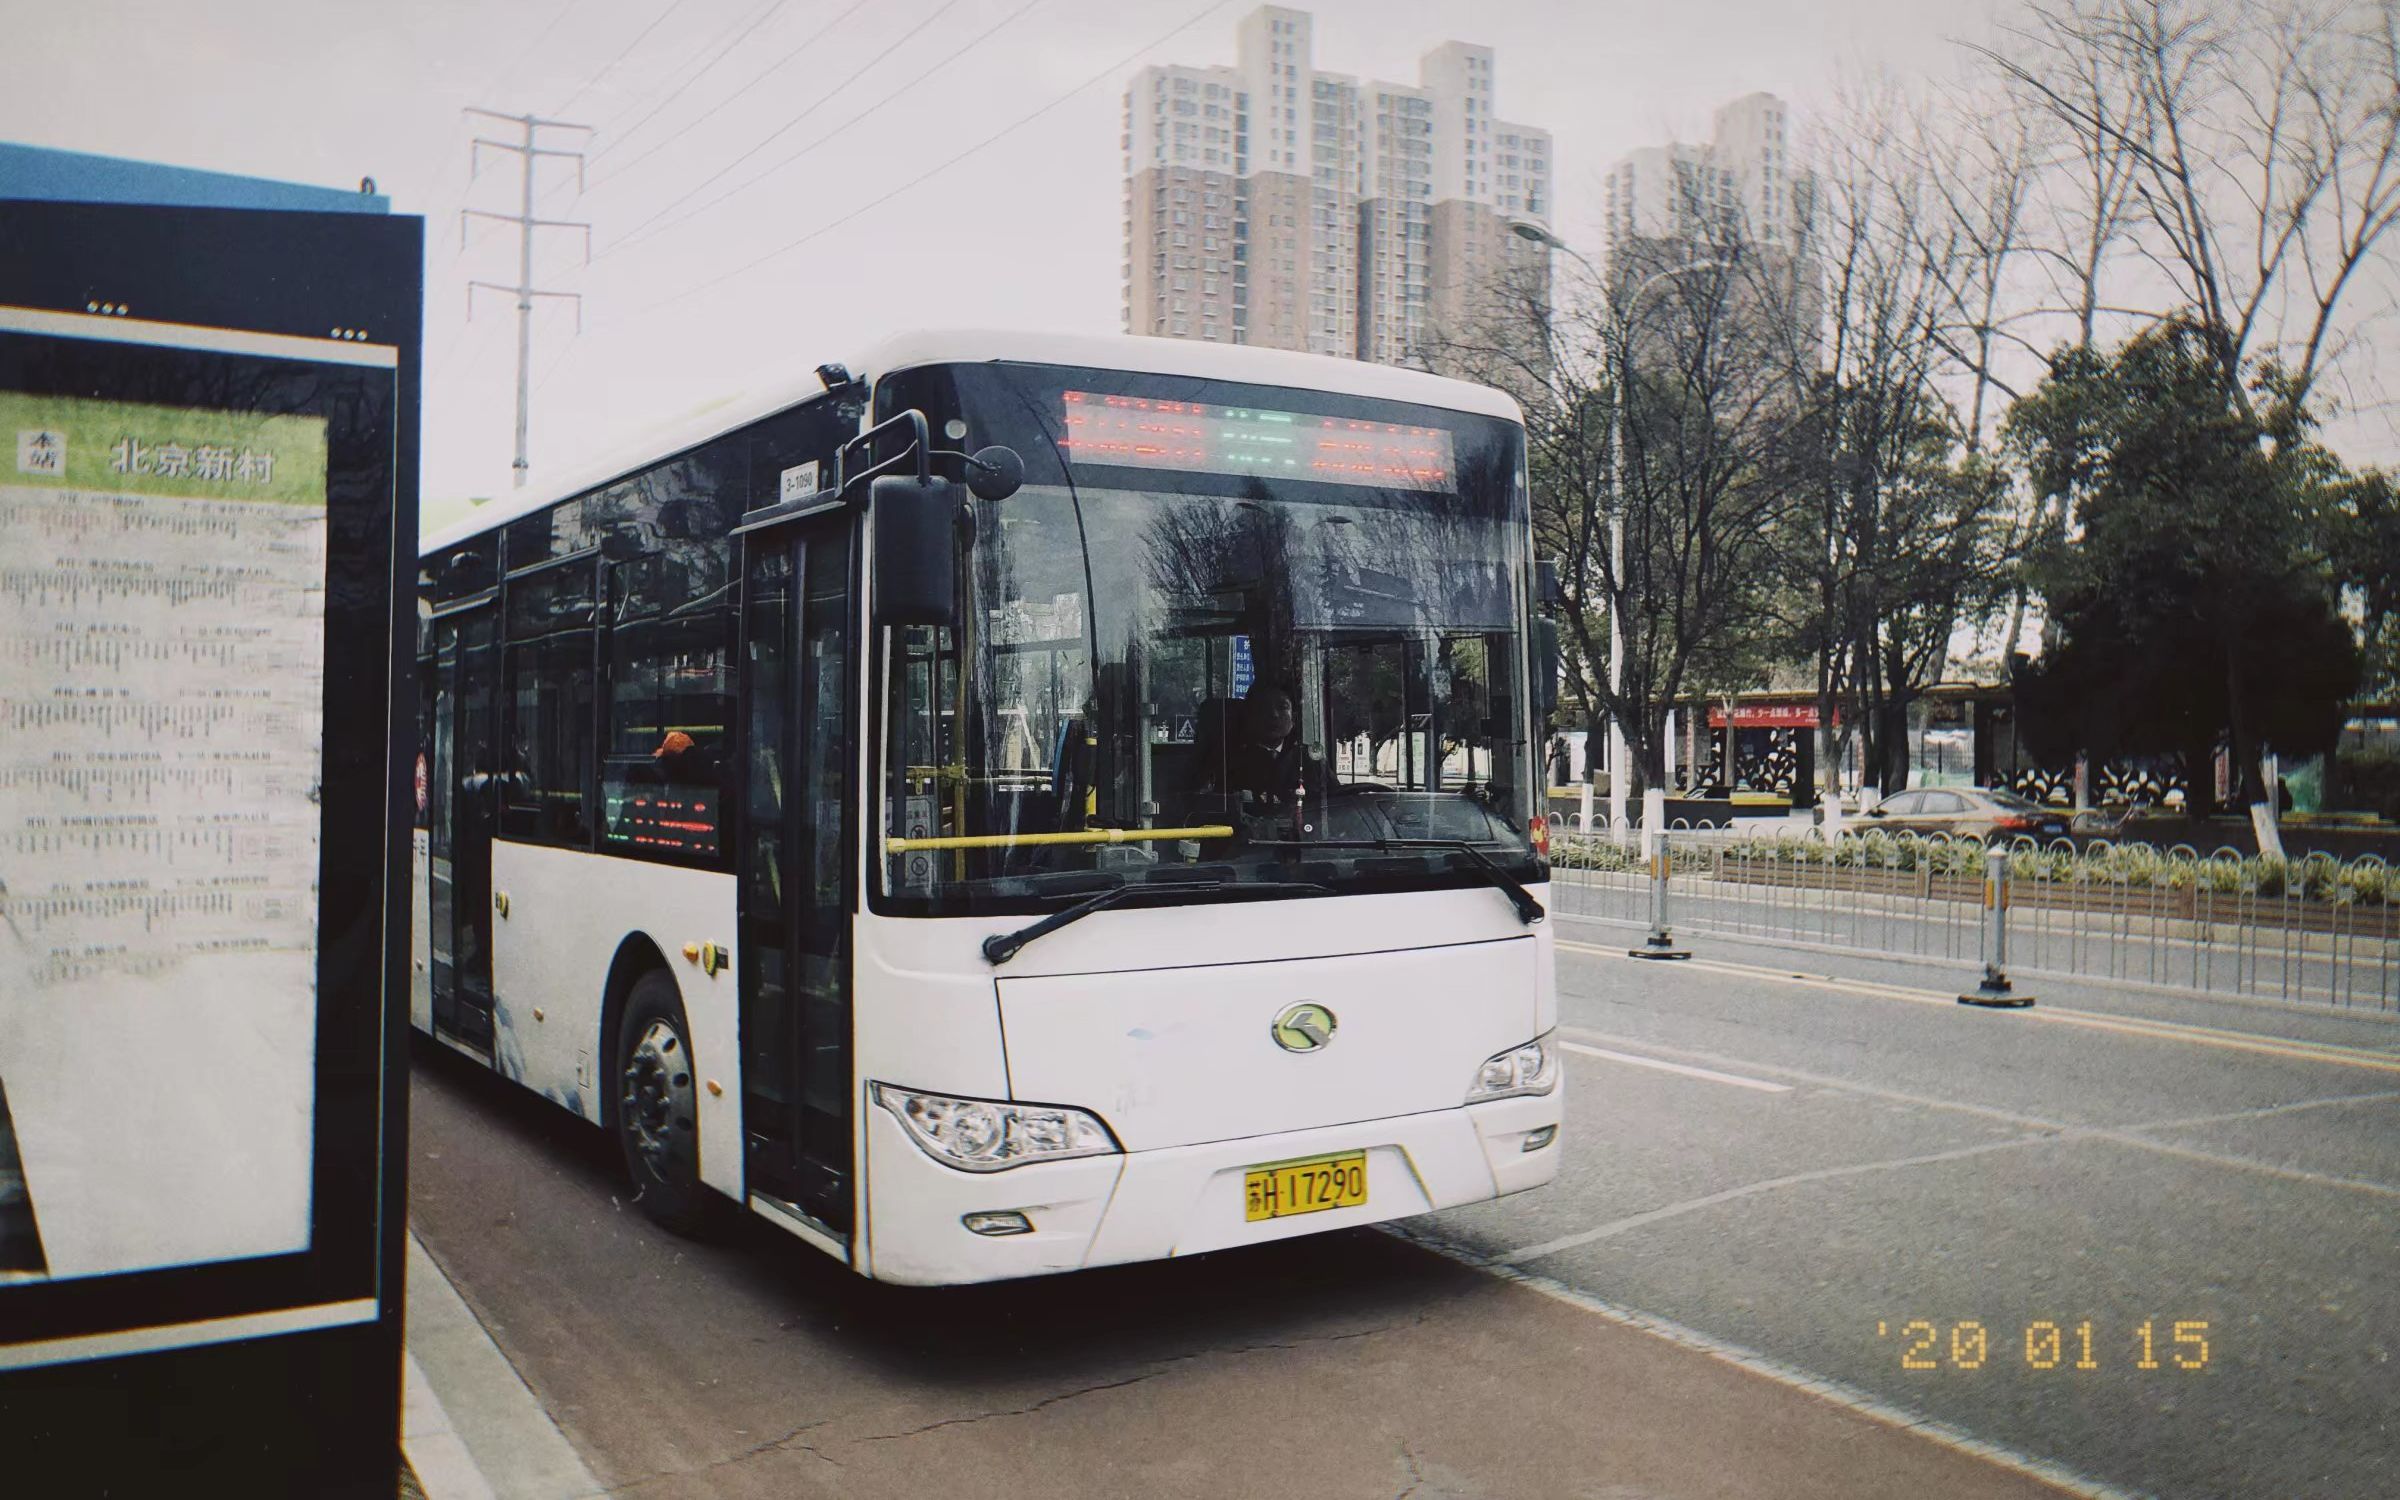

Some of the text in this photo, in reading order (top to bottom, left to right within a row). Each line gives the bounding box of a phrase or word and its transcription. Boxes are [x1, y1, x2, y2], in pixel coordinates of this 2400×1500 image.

[111, 435, 275, 483] 北京新村
[786, 471, 813, 492] 3-1090
